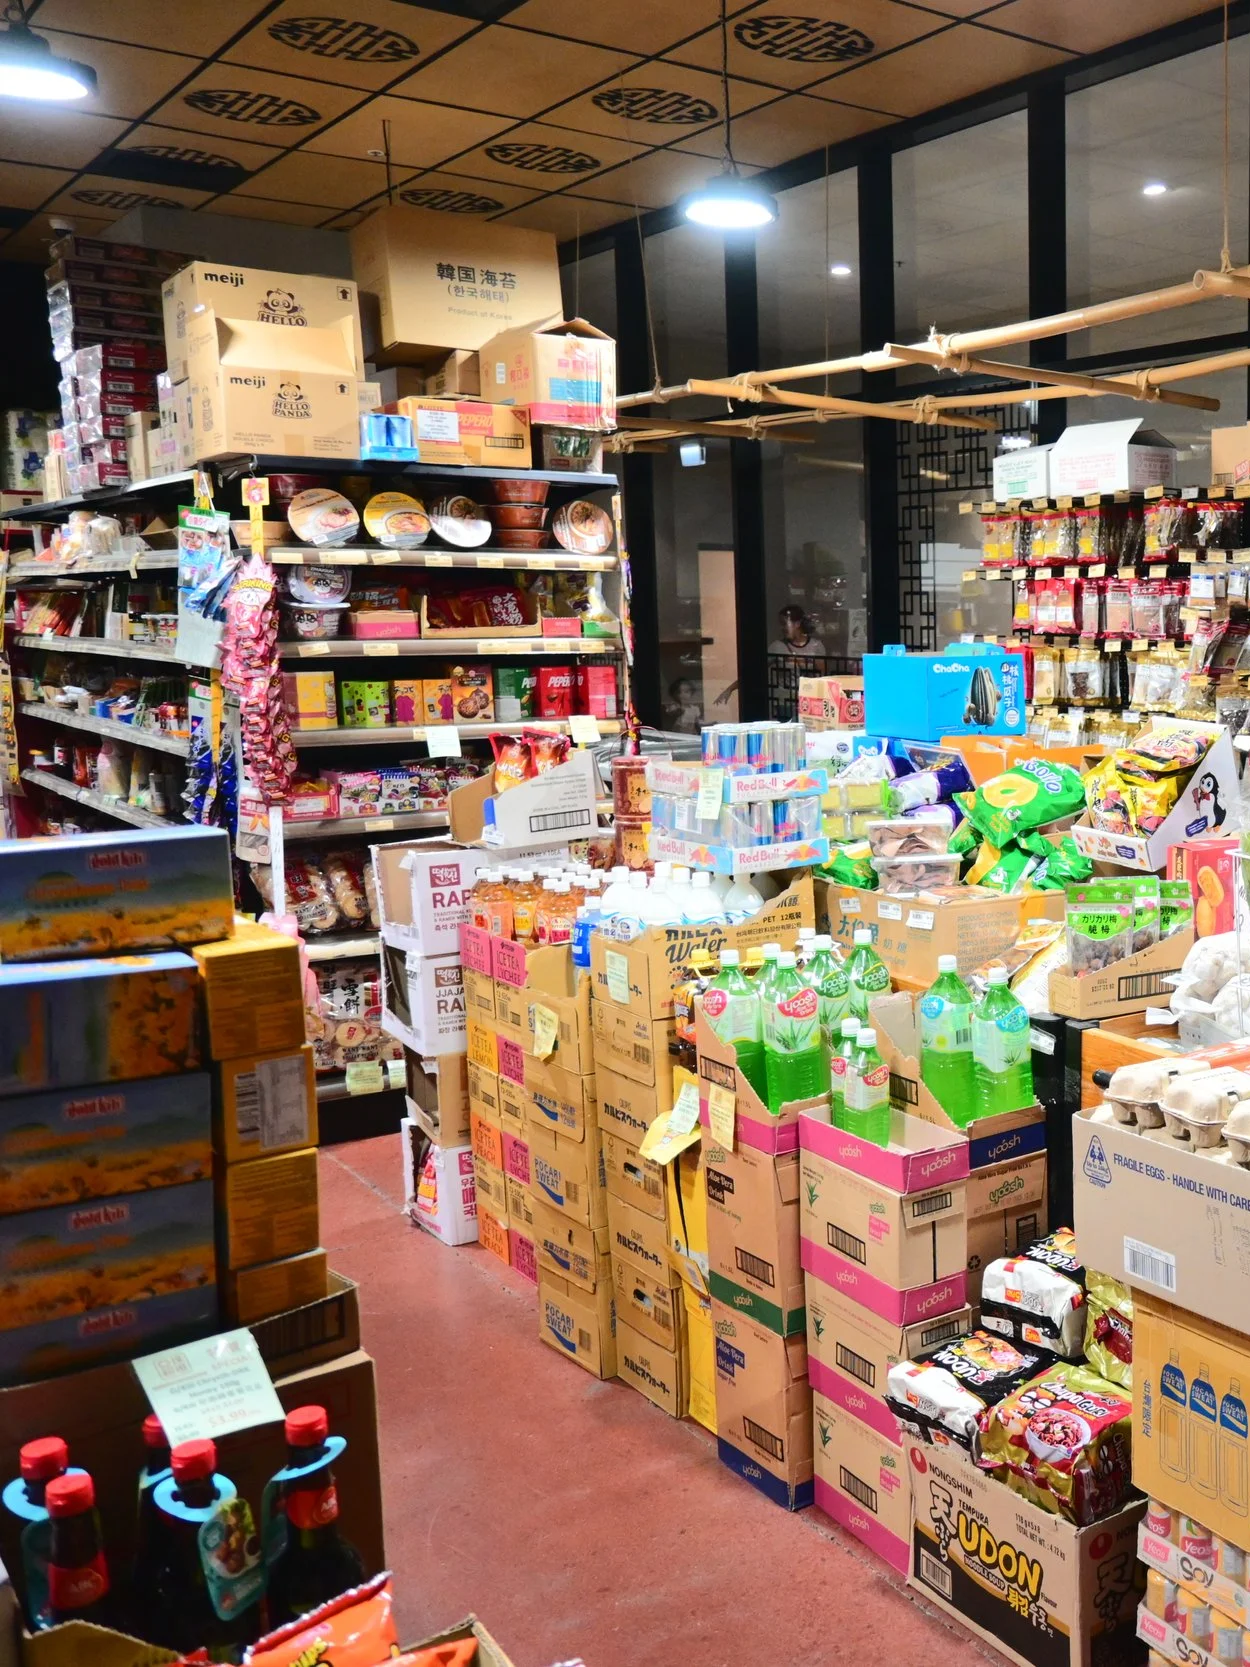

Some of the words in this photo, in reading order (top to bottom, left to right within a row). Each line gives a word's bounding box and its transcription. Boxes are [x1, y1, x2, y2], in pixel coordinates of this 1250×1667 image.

[204, 272, 244, 287] meiji
[260, 313, 305, 326] HELLO
[230, 376, 265, 388] meiji
[274, 409, 312, 418] PANDA
[275, 401, 308, 411] HELLO
[933, 663, 970, 674] ChaCha
[763, 915, 776, 923] PET
[1082, 914, 1117, 924] カリカリ梅
[819, 971, 849, 991] yoosh
[859, 967, 889, 987] yoosh
[784, 990, 816, 1012] yoosh
[839, 1143, 862, 1160] yoosh
[989, 1134, 1021, 1159] yoosh
[534, 1157, 561, 1179] POCARI
[921, 1150, 956, 1177] yoosh
[535, 1170, 560, 1190] SWEAT
[1113, 1153, 1144, 1174] FRAGILE
[1145, 1164, 1165, 1181] EGGS
[1172, 1173, 1204, 1196] HANDLE
[1206, 1185, 1228, 1203] WITH
[989, 1176, 1024, 1204] yoosh
[836, 1270, 858, 1285] yoosh
[733, 1294, 753, 1307] yoosh
[917, 1286, 952, 1313] yoosh
[545, 1303, 575, 1330] POCARI
[545, 1314, 573, 1337] SWEAT
[1162, 1368, 1185, 1383] POCARI
[1162, 1377, 1185, 1391] SWEAT
[1192, 1385, 1215, 1401] POCARI
[1192, 1392, 1215, 1408] SWEAT
[845, 1395, 867, 1411] yoosh
[1222, 1407, 1245, 1422] SWEAT
[742, 1464, 762, 1480] yoosh
[929, 1463, 973, 1499] NONGSHIM
[959, 1500, 989, 1526] TEMPURA
[848, 1513, 870, 1531] yoosh
[1149, 1520, 1164, 1535] eo's
[1029, 1531, 1038, 1543] NET
[957, 1511, 1042, 1599] UDON
[1184, 1541, 1213, 1556] Yeo's
[964, 1555, 988, 1583] NOODLE
[988, 1572, 1005, 1591] SOUP
[1180, 1556, 1214, 1588] Soy
